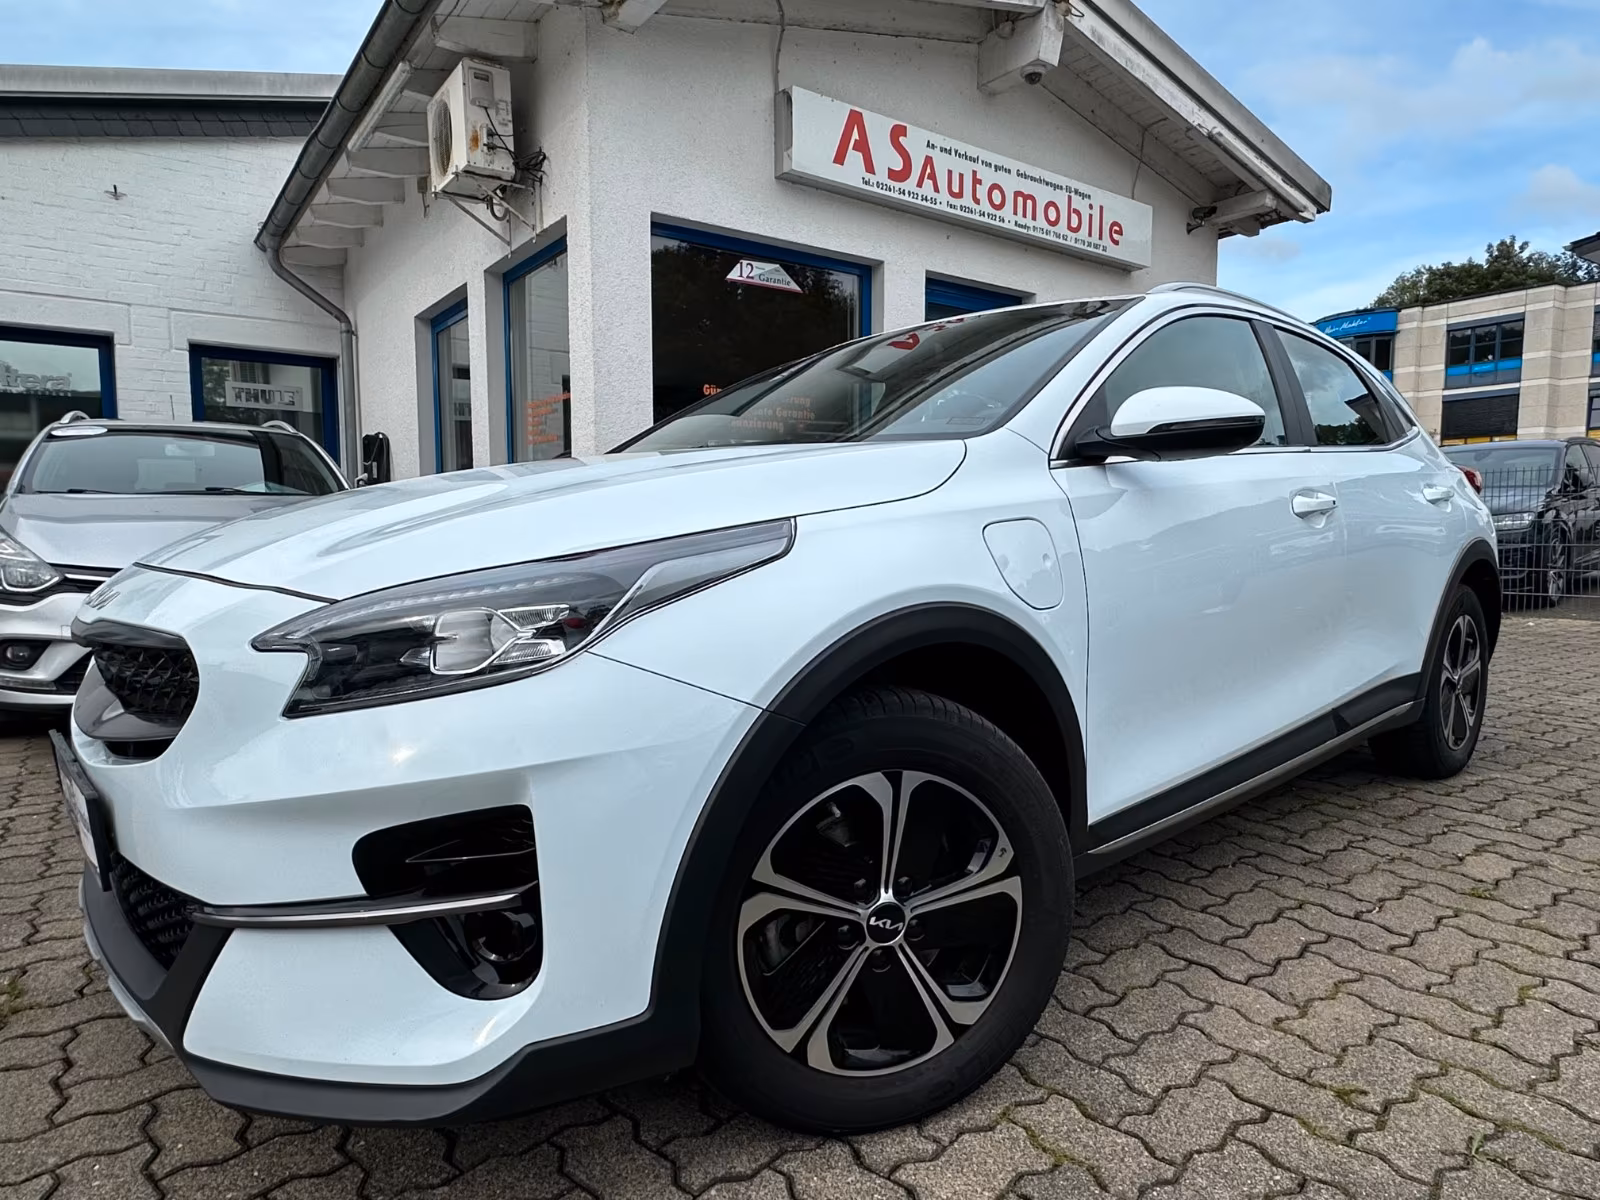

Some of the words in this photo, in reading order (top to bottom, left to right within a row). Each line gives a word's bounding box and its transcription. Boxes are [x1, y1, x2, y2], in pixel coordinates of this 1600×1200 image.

[926, 139, 938, 151] An-
[939, 145, 953, 156] und
[953, 148, 980, 164] Verkauf
[981, 159, 993, 169] von
[993, 163, 1012, 175] guten
[876, 181, 906, 197] 02261-54
[907, 190, 919, 200] 922
[920, 194, 938, 206] 54-55
[946, 200, 959, 211] Fax:
[960, 203, 986, 218] 02261-54
[986, 211, 998, 222] 922
[998, 215, 1005, 224] 56
[1014, 220, 1032, 233] Handy:
[916, 155, 1124, 246] Automobile
[737, 261, 754, 280] 12
[758, 274, 791, 287] Garantie
[232, 387, 296, 407] THULE
